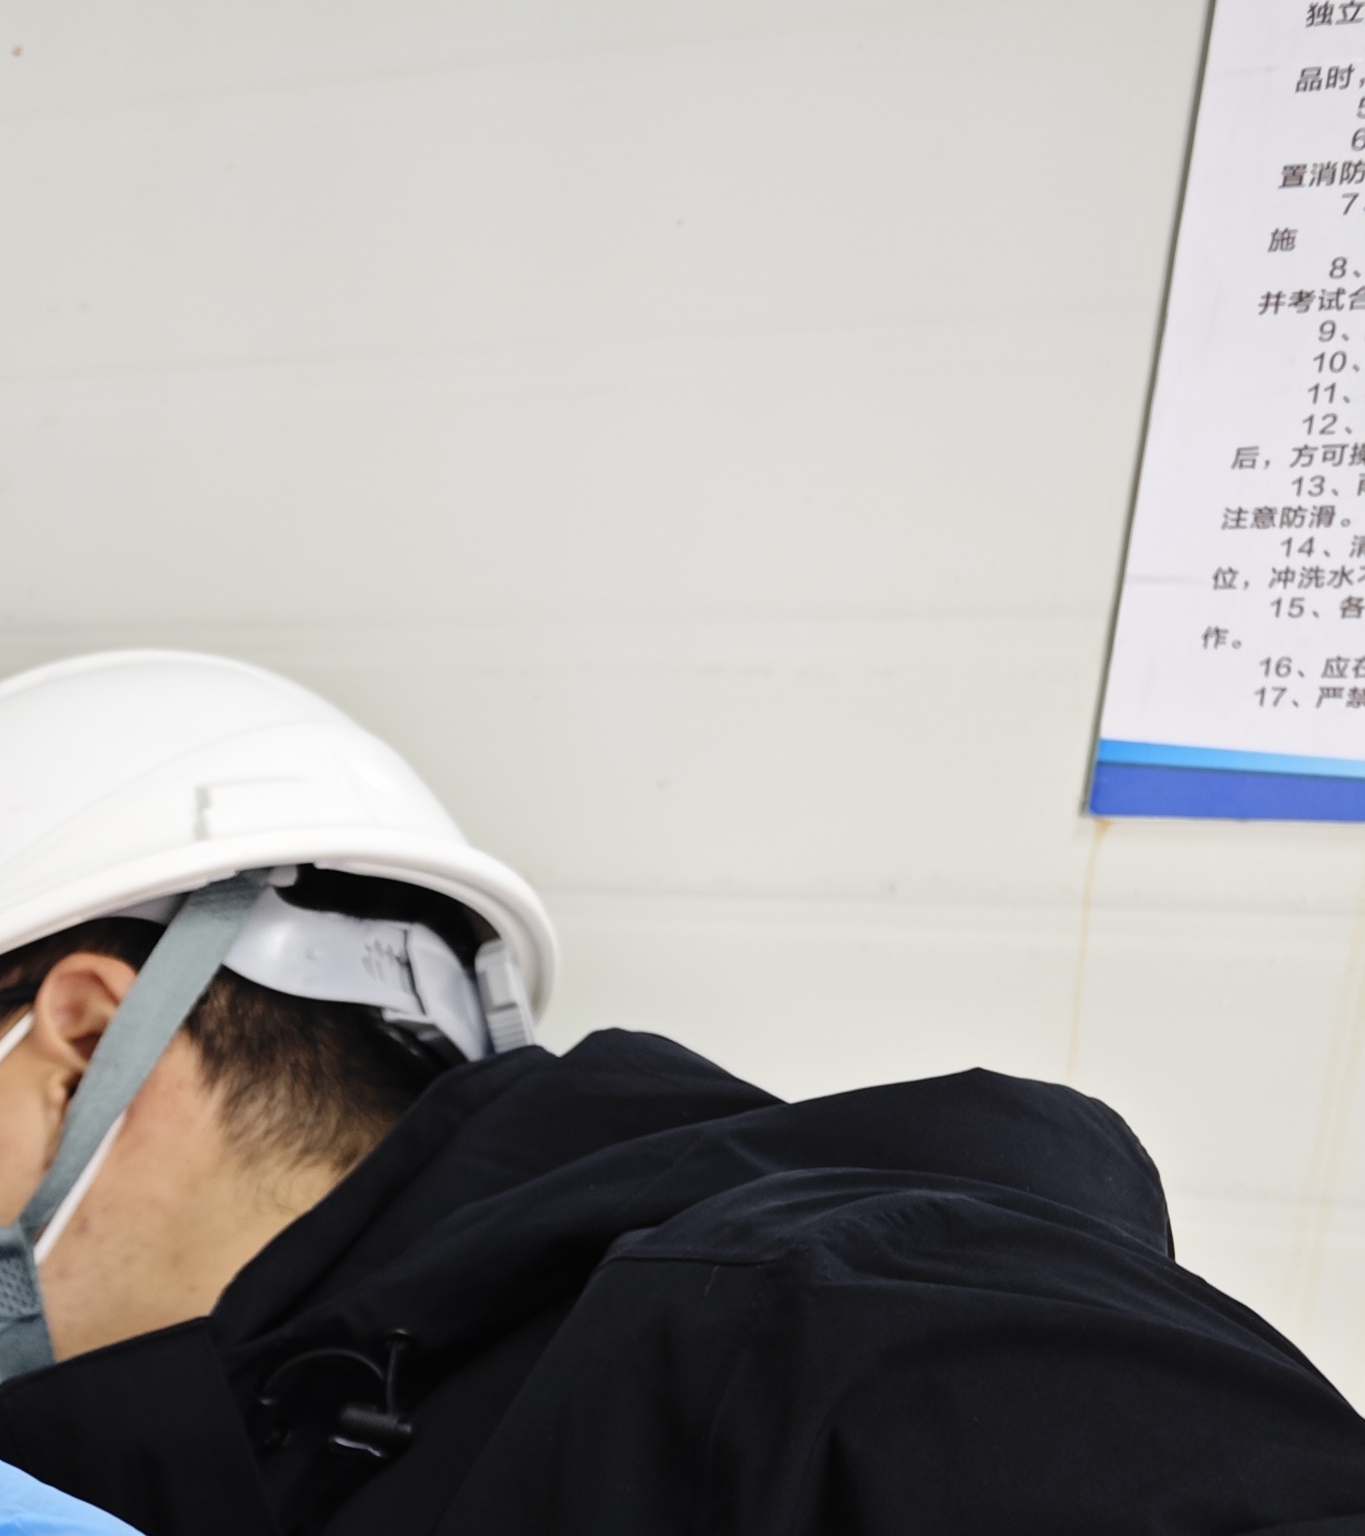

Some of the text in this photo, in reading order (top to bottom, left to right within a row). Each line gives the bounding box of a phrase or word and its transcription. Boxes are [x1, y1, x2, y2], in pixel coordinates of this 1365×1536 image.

[1305, 0, 1365, 29] 独立
[1294, 63, 1365, 94] 品时，
[1350, 127, 1365, 152] 6
[1278, 161, 1365, 189] 置消防
[1341, 192, 1365, 216] 7
[1267, 227, 1298, 253] 施
[1312, 350, 1360, 374] 10、
[1307, 382, 1351, 405] 11、
[1302, 412, 1353, 436] 12、
[1220, 504, 1351, 531] 注意防滑。
[1201, 625, 1242, 650] 作。
